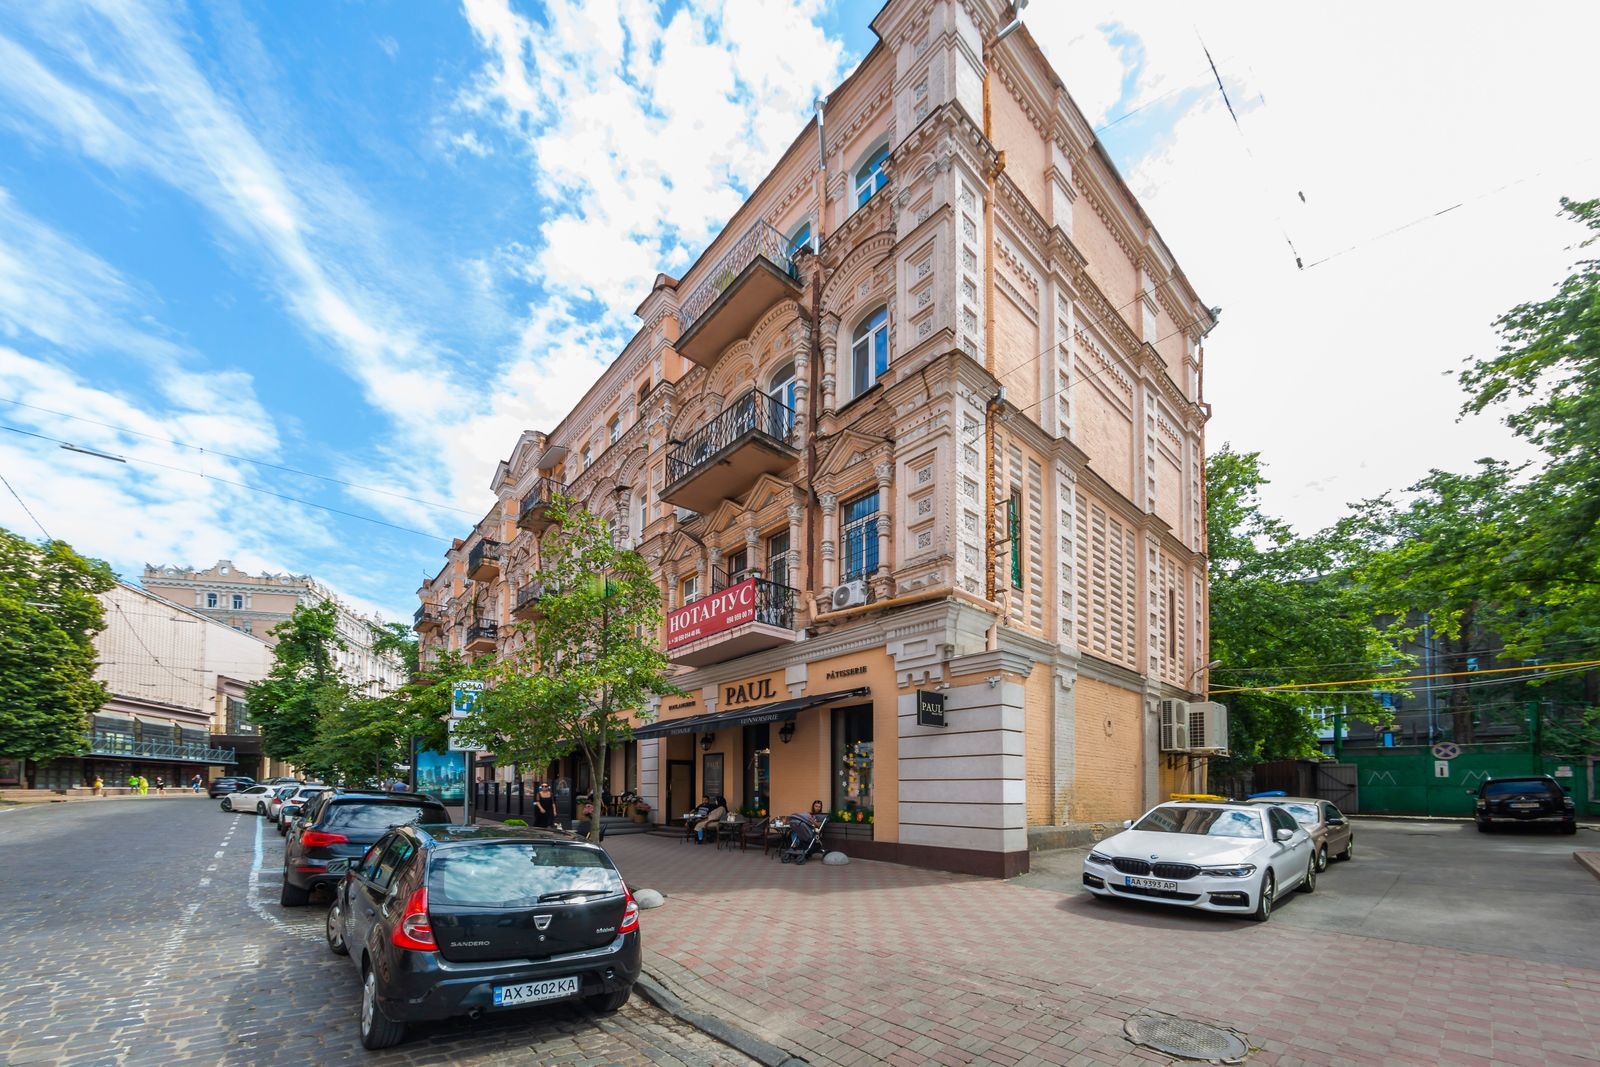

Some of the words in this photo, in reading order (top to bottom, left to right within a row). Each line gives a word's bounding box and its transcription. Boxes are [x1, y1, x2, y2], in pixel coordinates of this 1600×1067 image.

[670, 584, 752, 634] НОТАРІУС
[826, 666, 867, 680] PÂTISSERIE
[725, 679, 776, 705] PAUL
[921, 702, 943, 714] PAUL
[1131, 878, 1141, 886] AA
[1163, 882, 1175, 890] AP
[503, 986, 522, 1000] AX
[526, 982, 556, 997] 3602
[558, 980, 576, 992] KA
